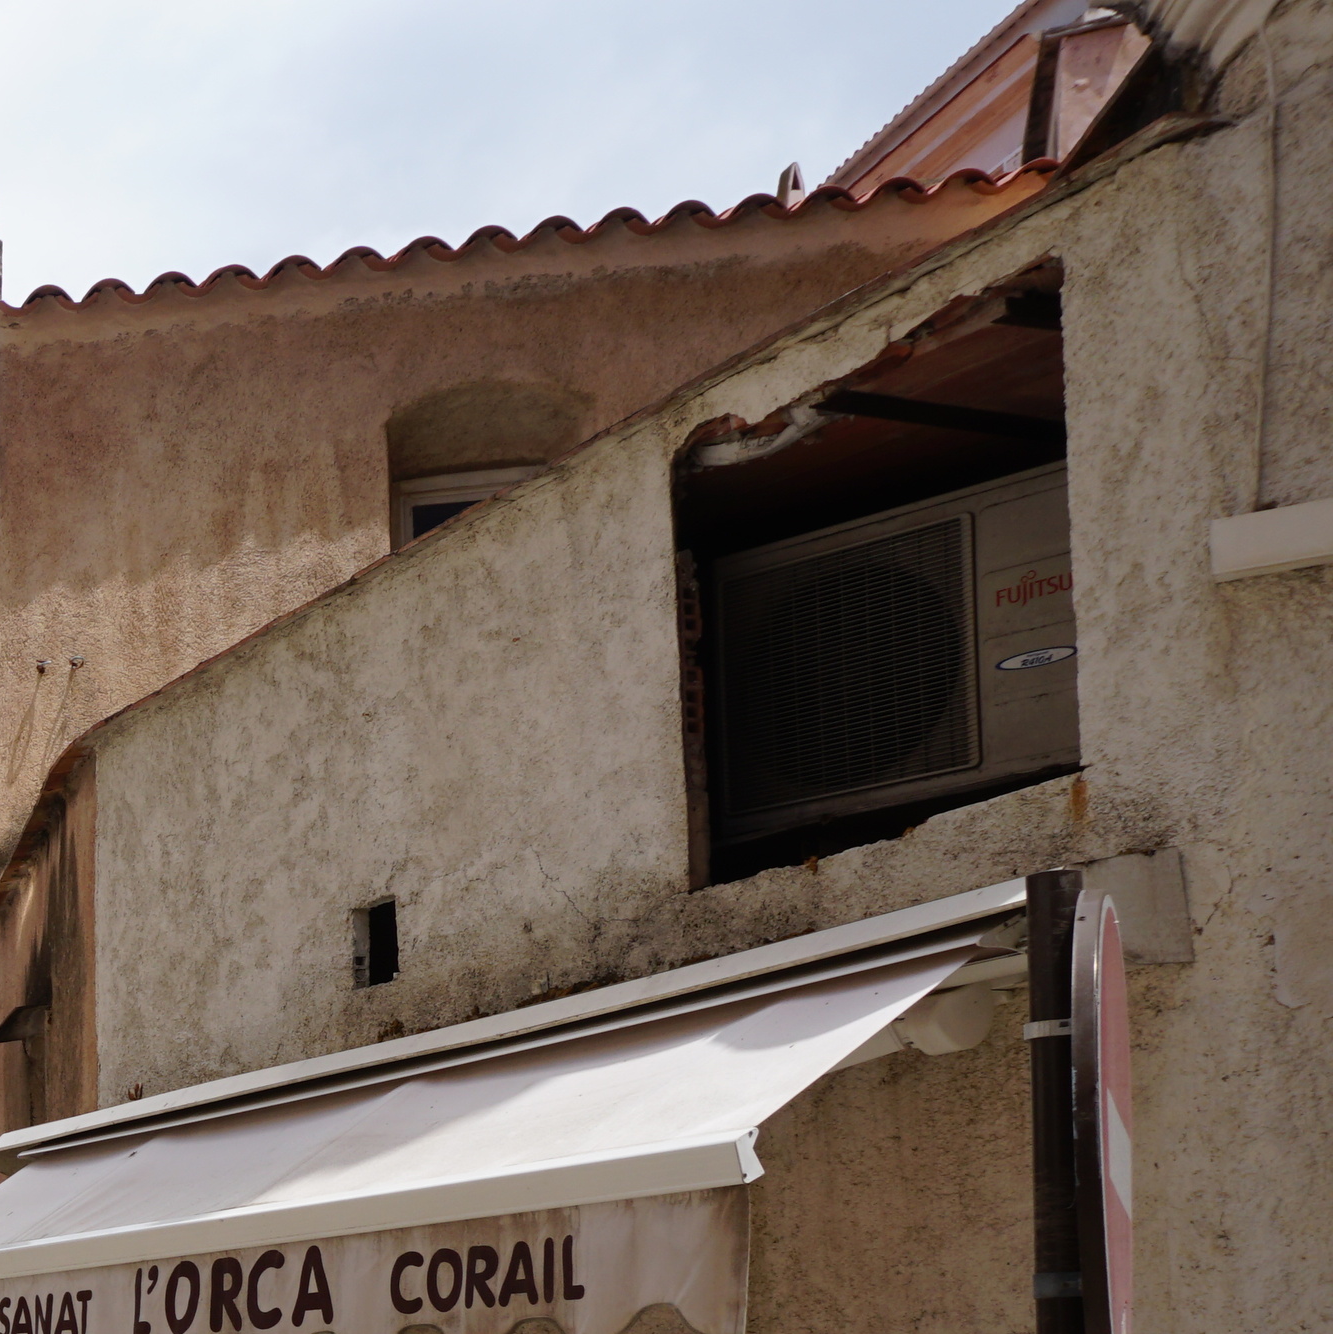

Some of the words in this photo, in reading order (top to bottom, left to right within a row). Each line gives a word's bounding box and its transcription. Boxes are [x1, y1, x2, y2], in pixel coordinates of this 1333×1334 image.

[996, 570, 1073, 607] FUJITSU
[1021, 653, 1054, 667] R410A
[390, 1234, 585, 1314] CORAIL
